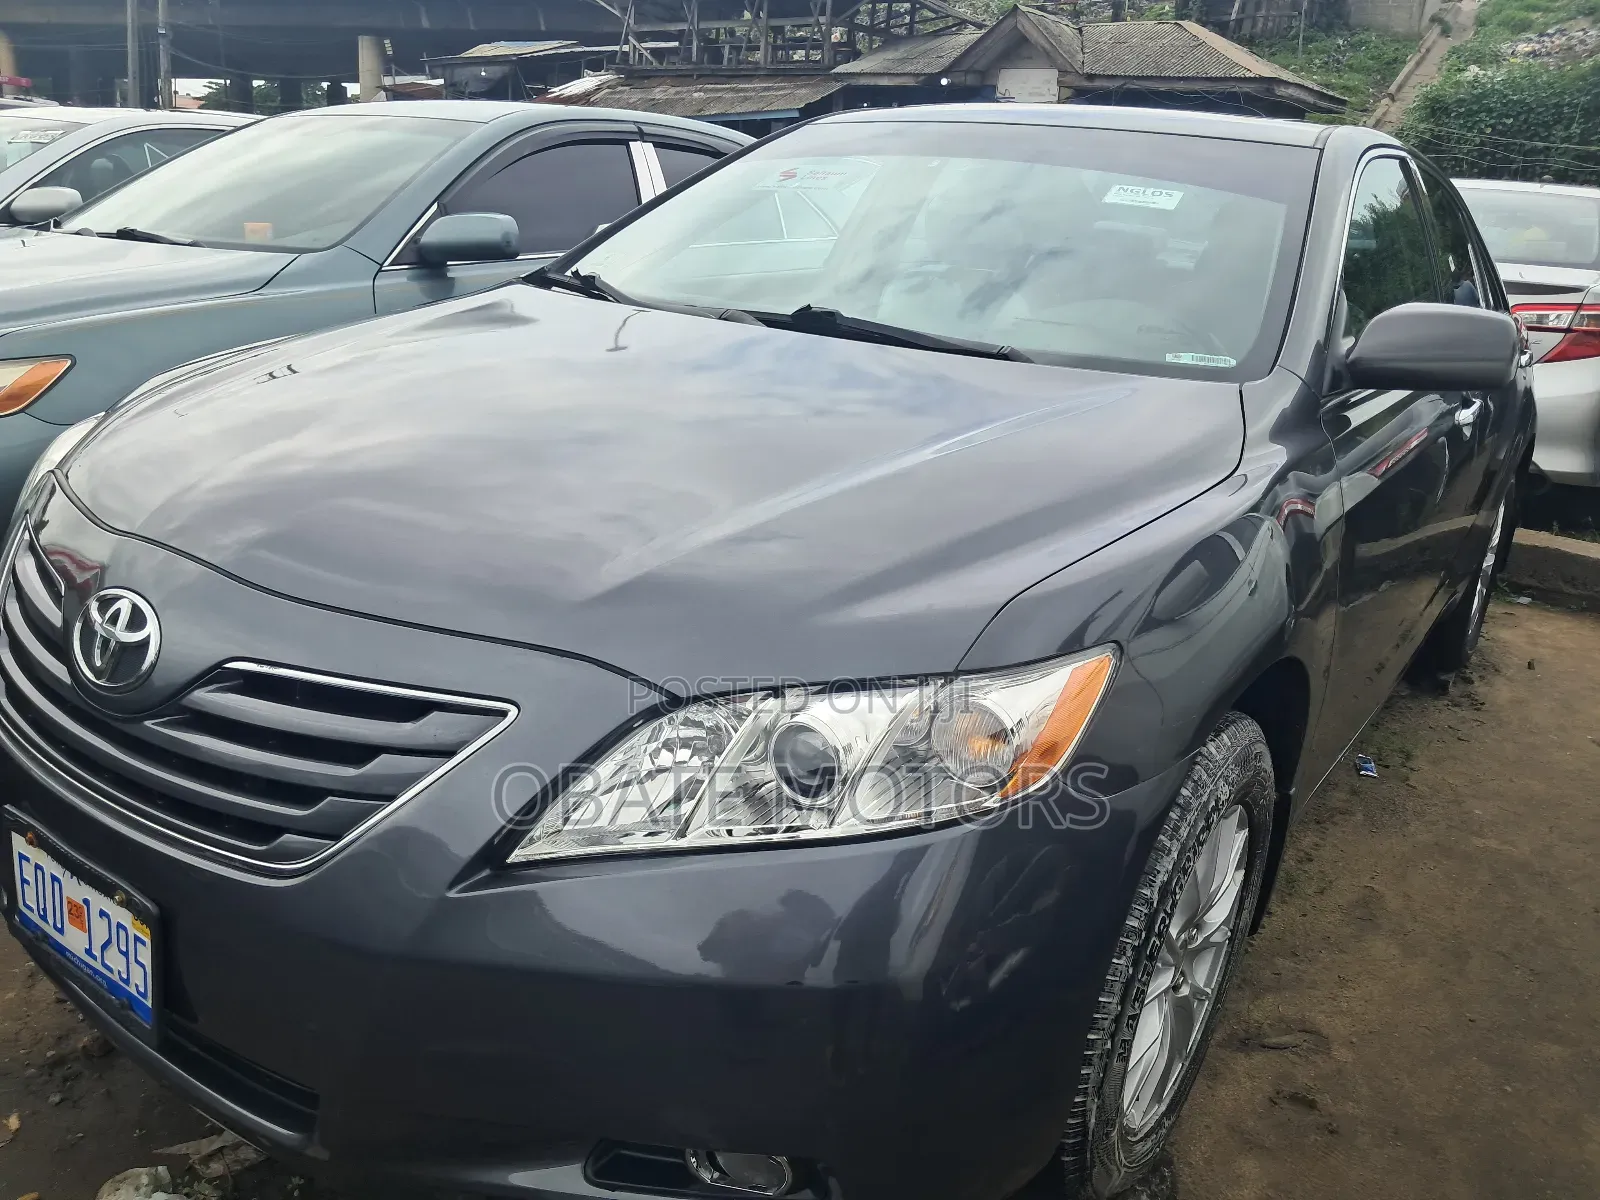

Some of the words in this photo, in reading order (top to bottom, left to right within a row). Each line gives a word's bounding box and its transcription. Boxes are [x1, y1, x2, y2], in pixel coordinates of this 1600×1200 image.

[1116, 186, 1175, 198] NGLOS
[17, 851, 65, 937] EQD
[82, 897, 149, 1002] 1295
